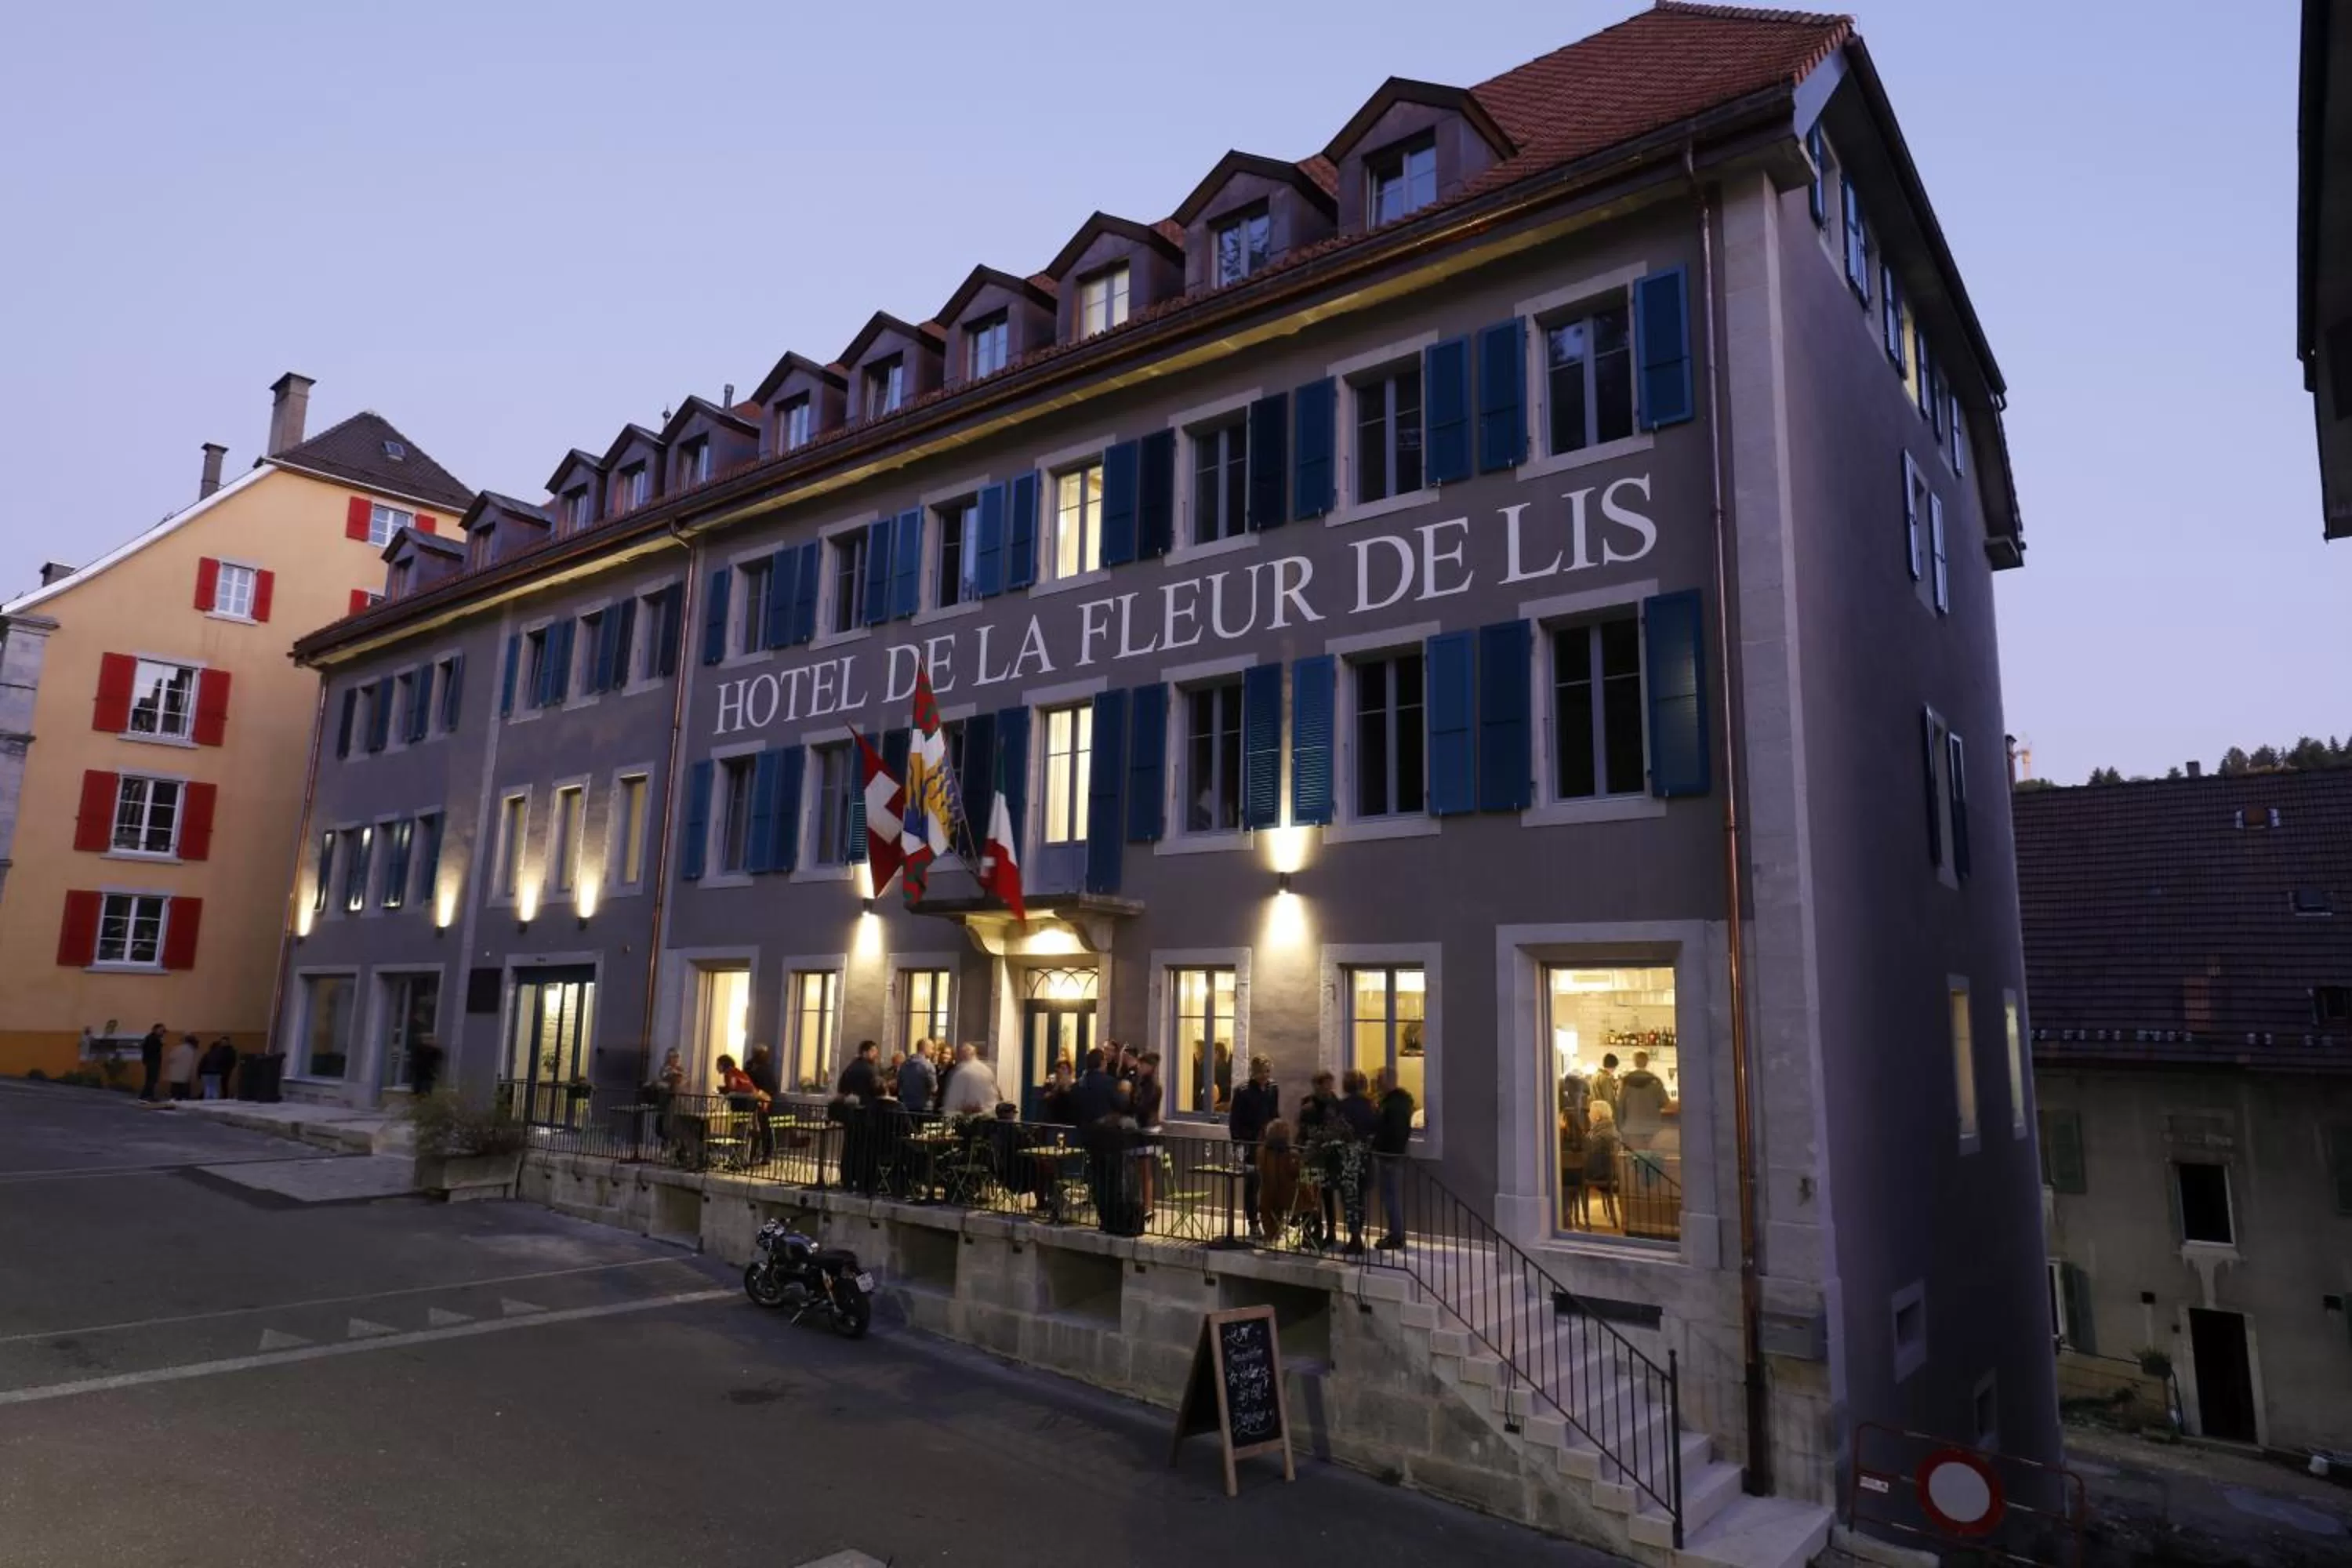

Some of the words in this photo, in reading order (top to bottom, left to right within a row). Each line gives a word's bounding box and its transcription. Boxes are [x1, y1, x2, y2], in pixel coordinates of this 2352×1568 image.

[713, 655, 868, 735] HOTEL
[882, 633, 956, 703] DE
[973, 614, 1056, 686] LA
[1076, 555, 1326, 666] FLEUR
[1348, 517, 1473, 614] DE
[1497, 474, 1657, 585] LIS
